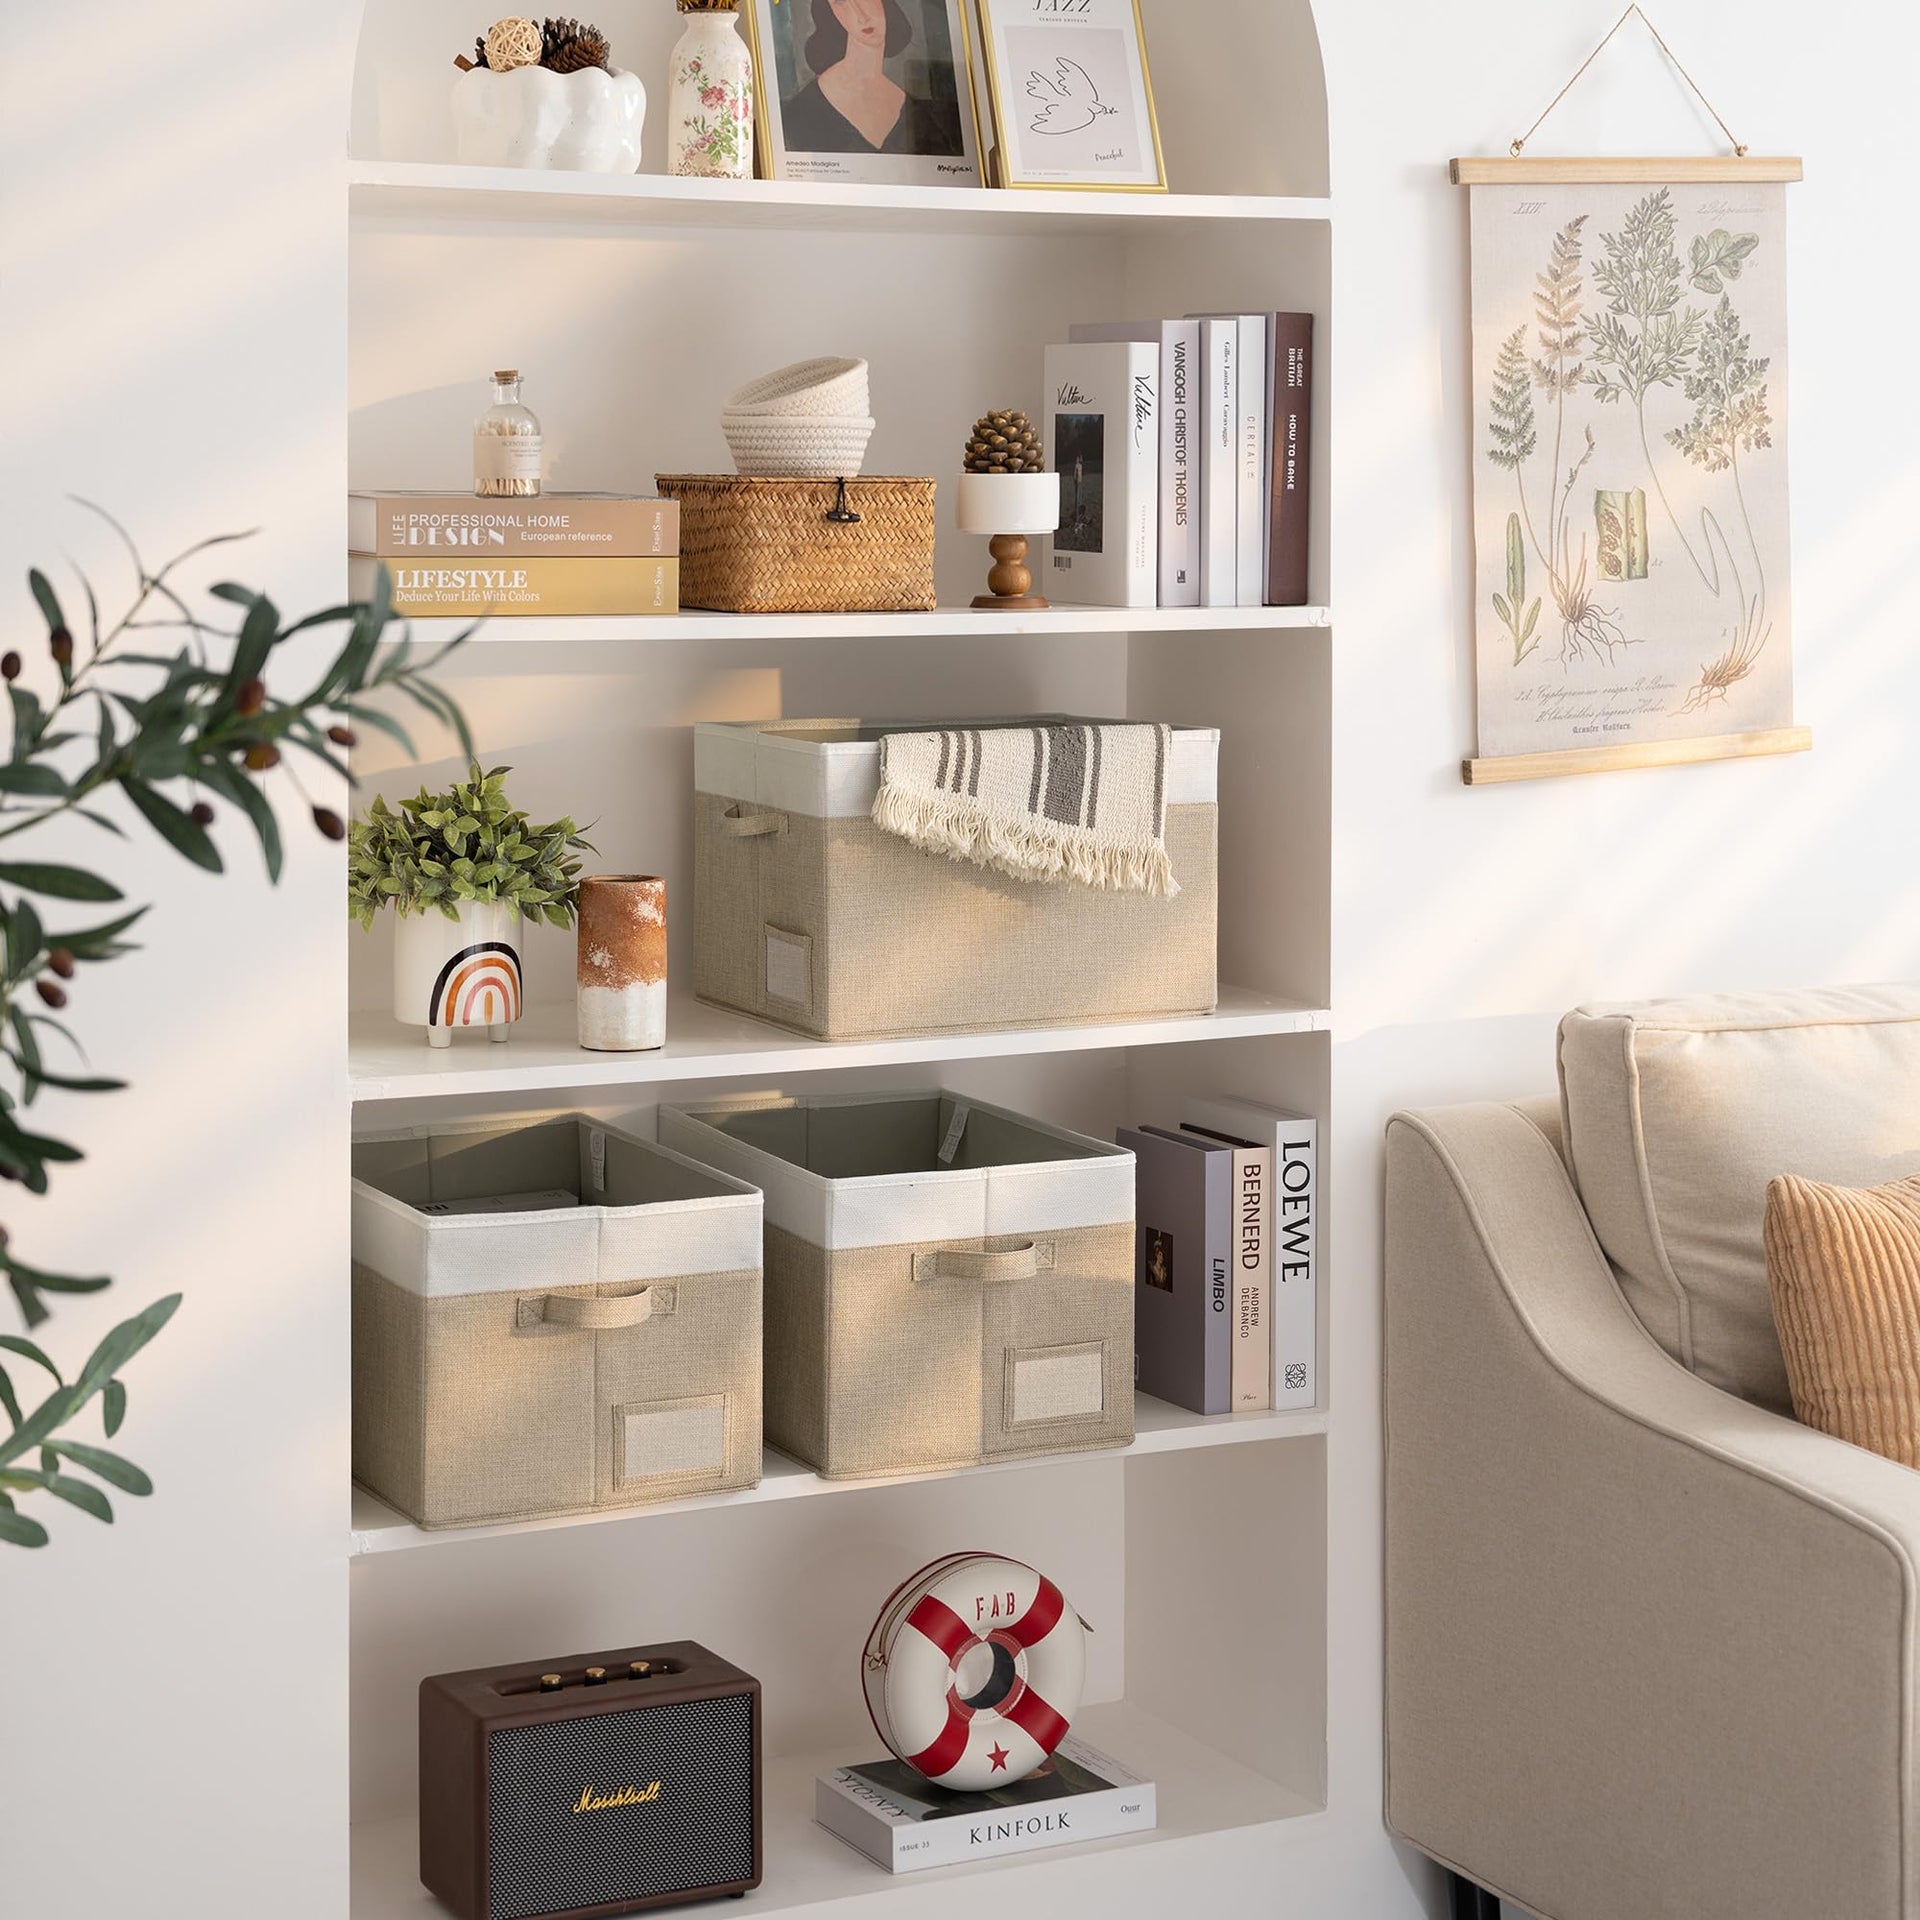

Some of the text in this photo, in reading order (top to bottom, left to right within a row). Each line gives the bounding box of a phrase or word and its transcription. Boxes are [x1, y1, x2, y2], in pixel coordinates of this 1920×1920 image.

[1288, 347, 1296, 387] BRITISH
[1174, 341, 1188, 526] VANGOGH CHRISTOF THOENES
[1246, 416, 1256, 466] CEREAL
[1287, 414, 1297, 491] HOW TO BAKE
[392, 515, 405, 545] LIFE
[409, 514, 570, 528] PROFESSIONAL HOME
[409, 527, 505, 546] DESIGN
[521, 531, 613, 543] European reference
[396, 569, 528, 589] LIFESTYLE
[396, 590, 540, 602] Deduce Your Life With Colors
[1241, 1163, 1262, 1270] BERNERD
[1281, 1139, 1311, 1283] LOEWE
[1212, 1258, 1226, 1313] LIMBO
[1240, 1287, 1250, 1339] DELBANCO
[1250, 1287, 1260, 1327] ANDREW
[976, 1592, 1016, 1621] FAB
[834, 1774, 911, 1818] KINFOLK
[899, 1843, 920, 1852] ISSUE
[968, 1812, 1071, 1845] KINFOLK
